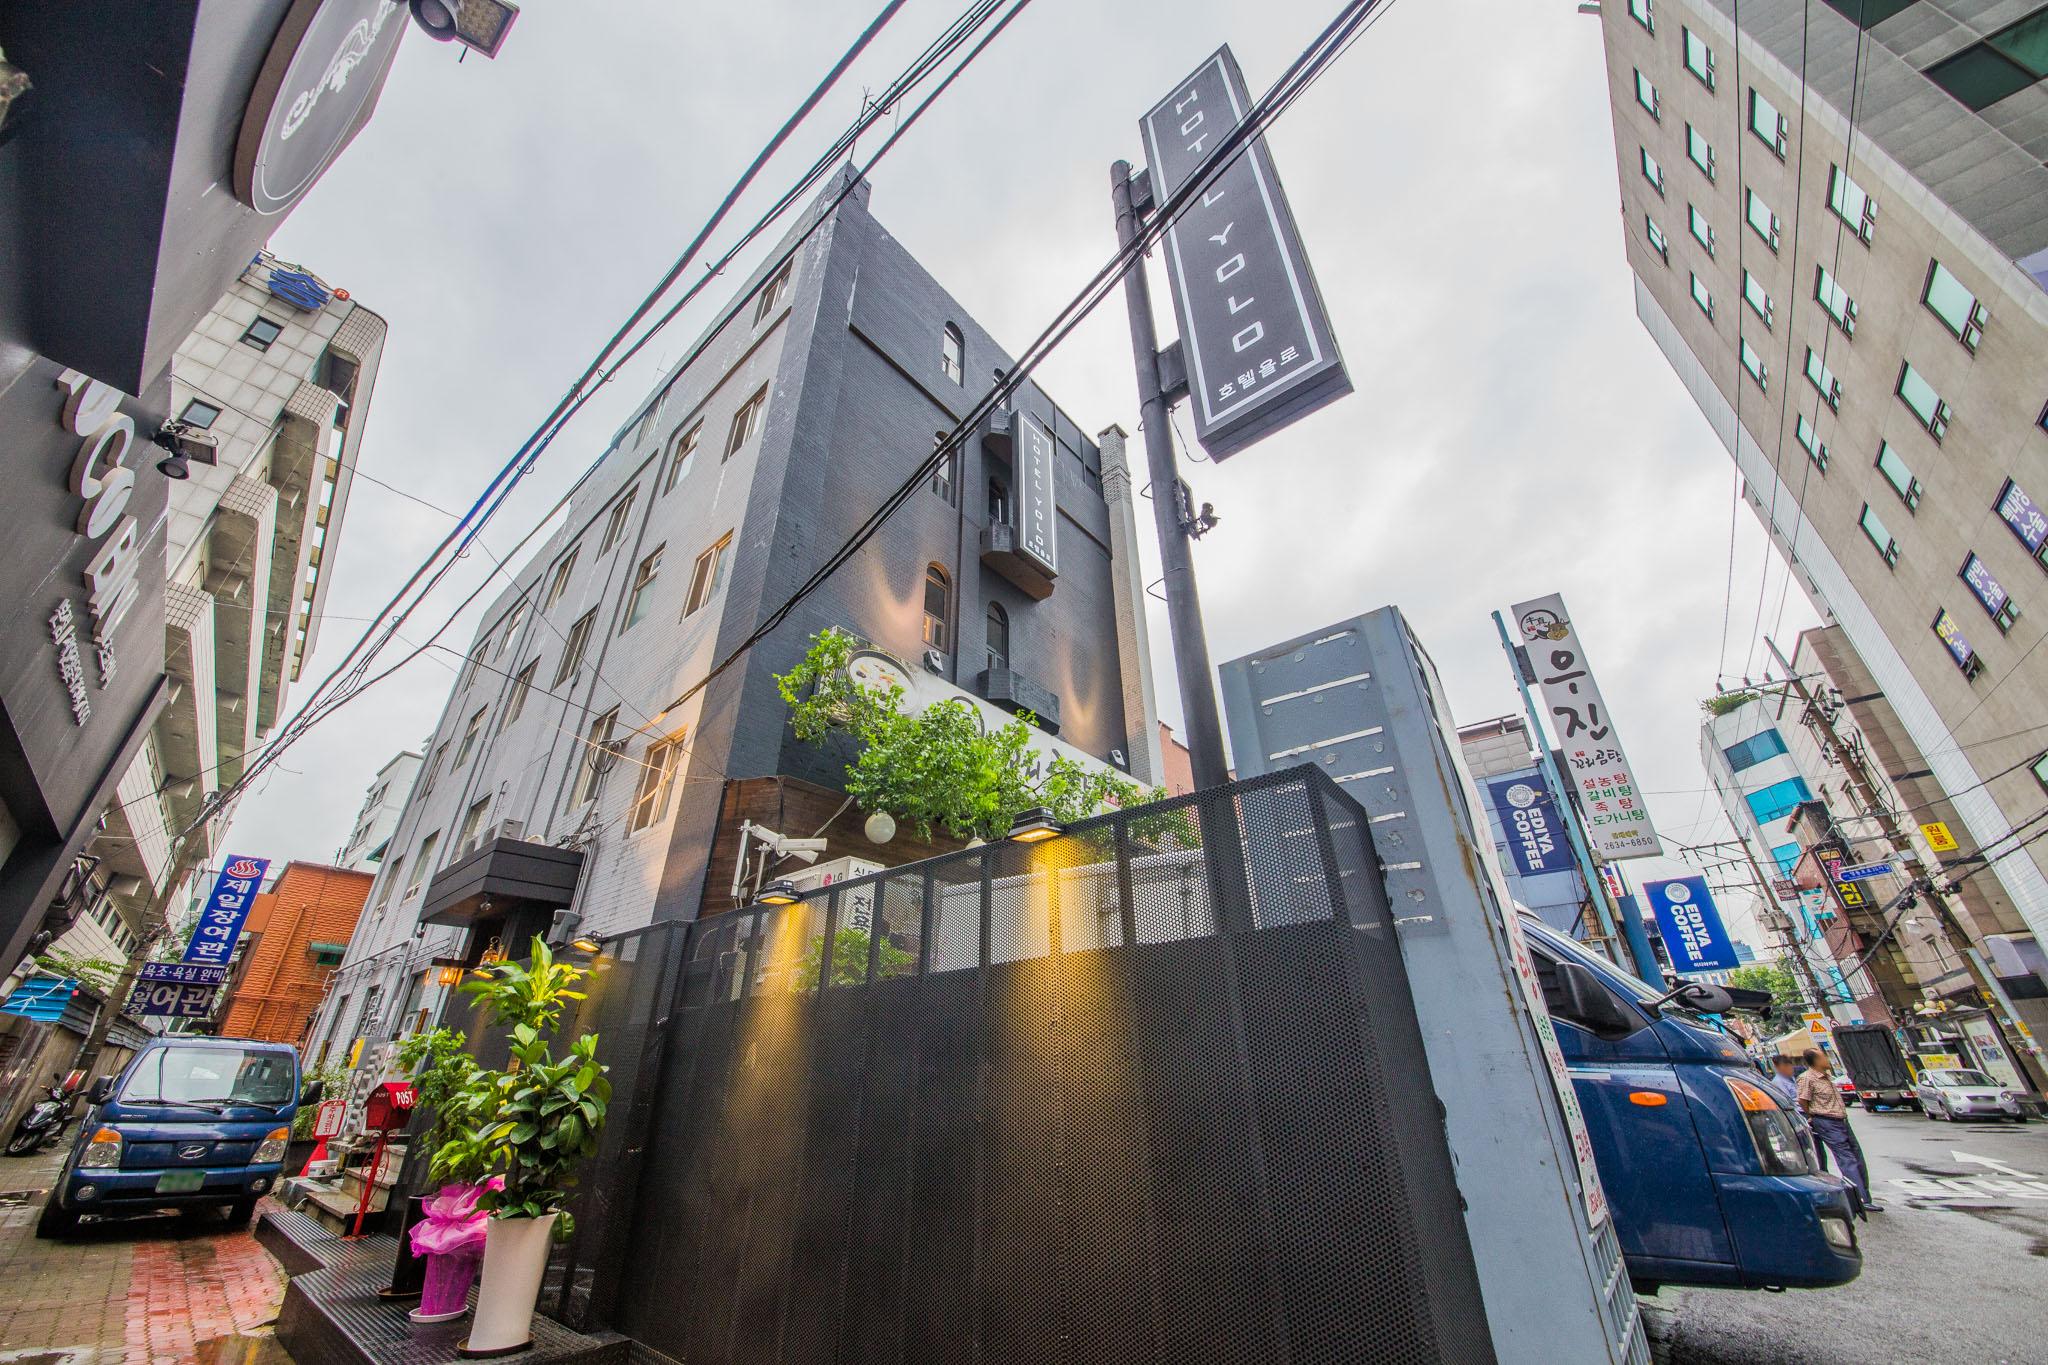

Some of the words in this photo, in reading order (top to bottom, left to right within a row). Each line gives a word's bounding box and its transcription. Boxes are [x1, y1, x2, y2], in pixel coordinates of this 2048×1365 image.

[1175, 89, 1225, 208] HOTL
[1208, 222, 1264, 352] YOLO
[1032, 433, 1042, 491] HOTEL
[2000, 484, 2031, 522] 백내장
[1034, 496, 1044, 546] YOLO
[2021, 510, 2047, 543] 수술
[1966, 559, 1989, 589] 망막
[1982, 580, 2004, 609] 수술
[1936, 613, 1960, 645] 안과
[1543, 650, 1609, 741] 우진
[1583, 773, 1628, 789] 설농탕
[1587, 785, 1633, 801] 갈비탕
[1527, 808, 1555, 855] EDIYA
[1593, 809, 1645, 825] 도가니탕
[1513, 810, 1545, 870] COFFEE
[1604, 837, 1653, 850] 2634-6850
[833, 872, 843, 882] LG
[194, 878, 254, 956] 제일장여관
[1670, 905, 1703, 960] COFFEE
[1684, 904, 1712, 948] EDIYA
[200, 968, 225, 983] 완비
[151, 983, 216, 1014] 여관
[395, 1091, 413, 1105] POST
